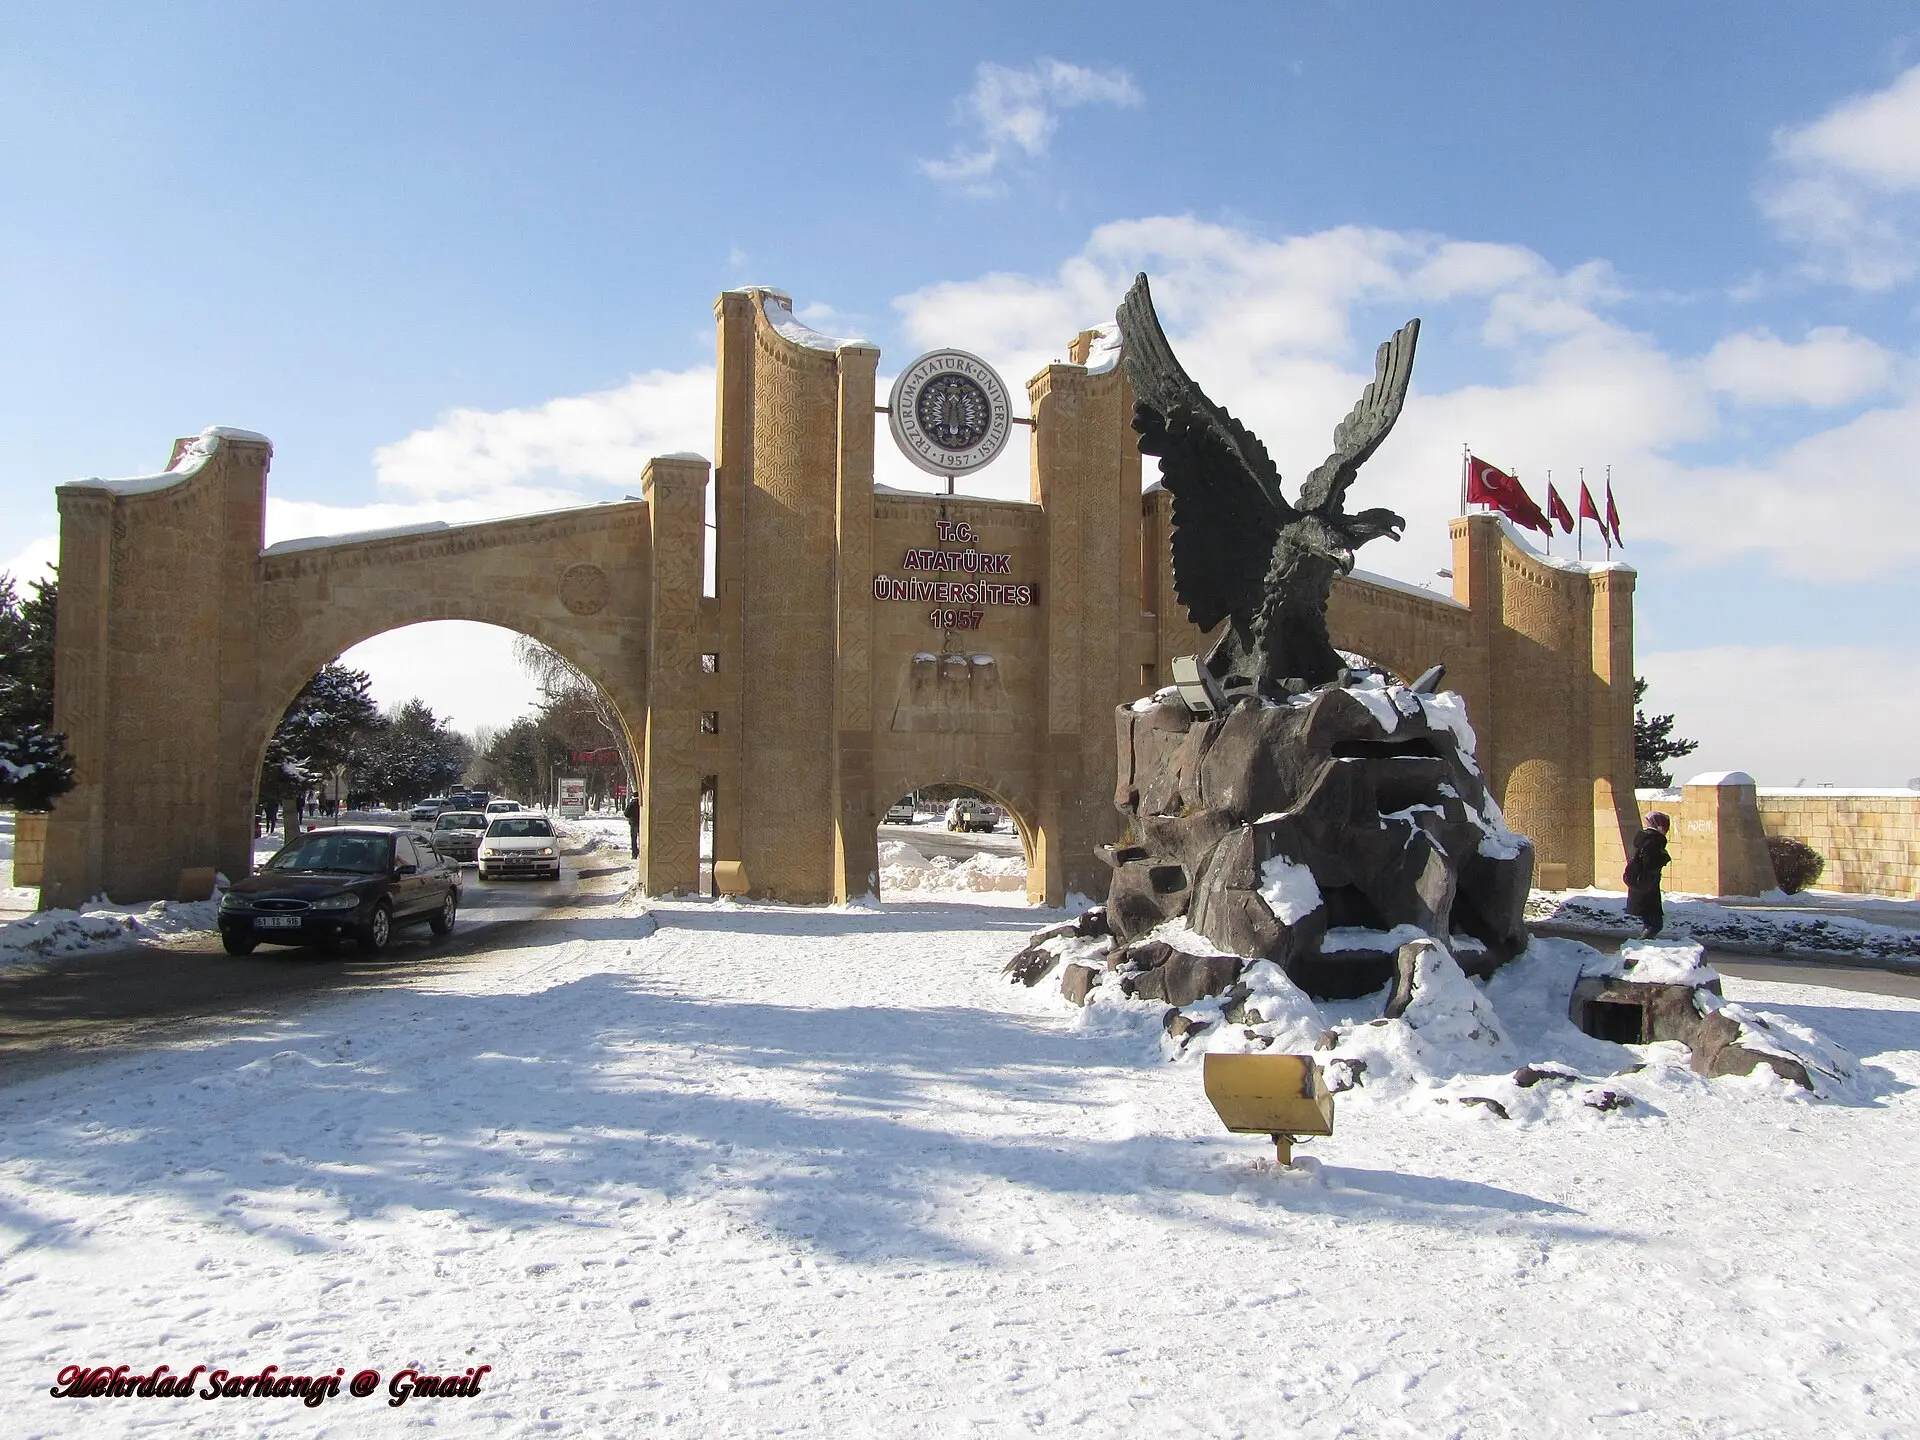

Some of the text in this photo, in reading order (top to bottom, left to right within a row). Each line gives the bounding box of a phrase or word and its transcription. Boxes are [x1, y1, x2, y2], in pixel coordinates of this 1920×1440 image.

[914, 358, 974, 386] ATATÜRK
[902, 386, 931, 455] ERZURUM
[939, 453, 970, 467] 1957
[936, 520, 979, 542] T.C.
[904, 549, 1011, 573] ATATÜRK
[930, 608, 985, 630] 1957
